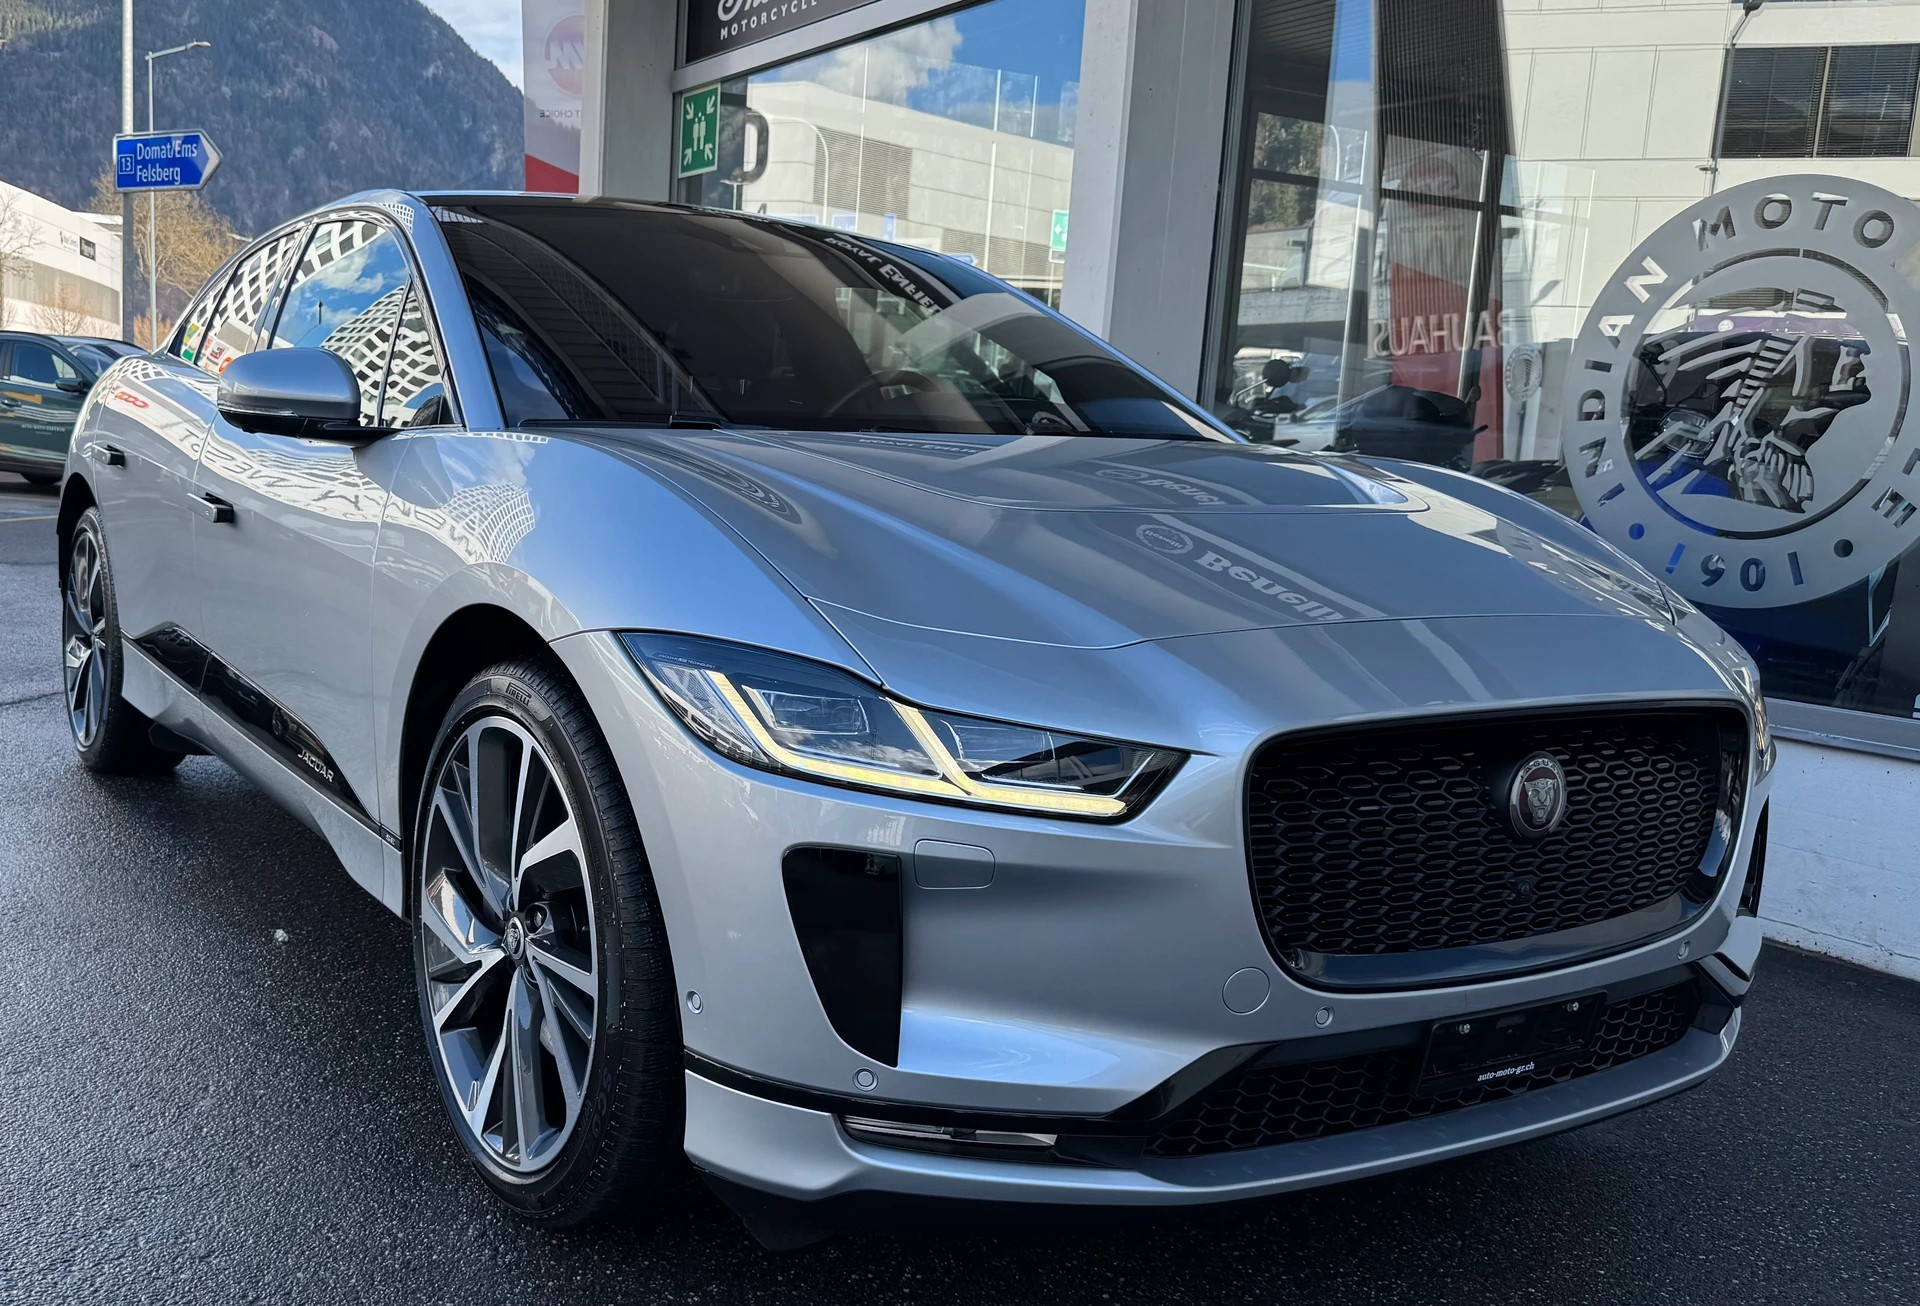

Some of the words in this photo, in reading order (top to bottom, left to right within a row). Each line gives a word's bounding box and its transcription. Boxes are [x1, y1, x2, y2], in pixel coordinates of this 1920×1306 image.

[136, 140, 198, 160] Domat/Ems
[121, 157, 132, 171] 13
[136, 163, 181, 185] Felsberg
[1577, 256, 1668, 506] INDIAN
[1692, 191, 1895, 252] MOTO
[1665, 542, 1804, 592] 1901
[505, 681, 532, 706] PIRELLI
[297, 749, 334, 783] JAGUAR
[1477, 1062, 1535, 1082] auto-moto-gr.ch
